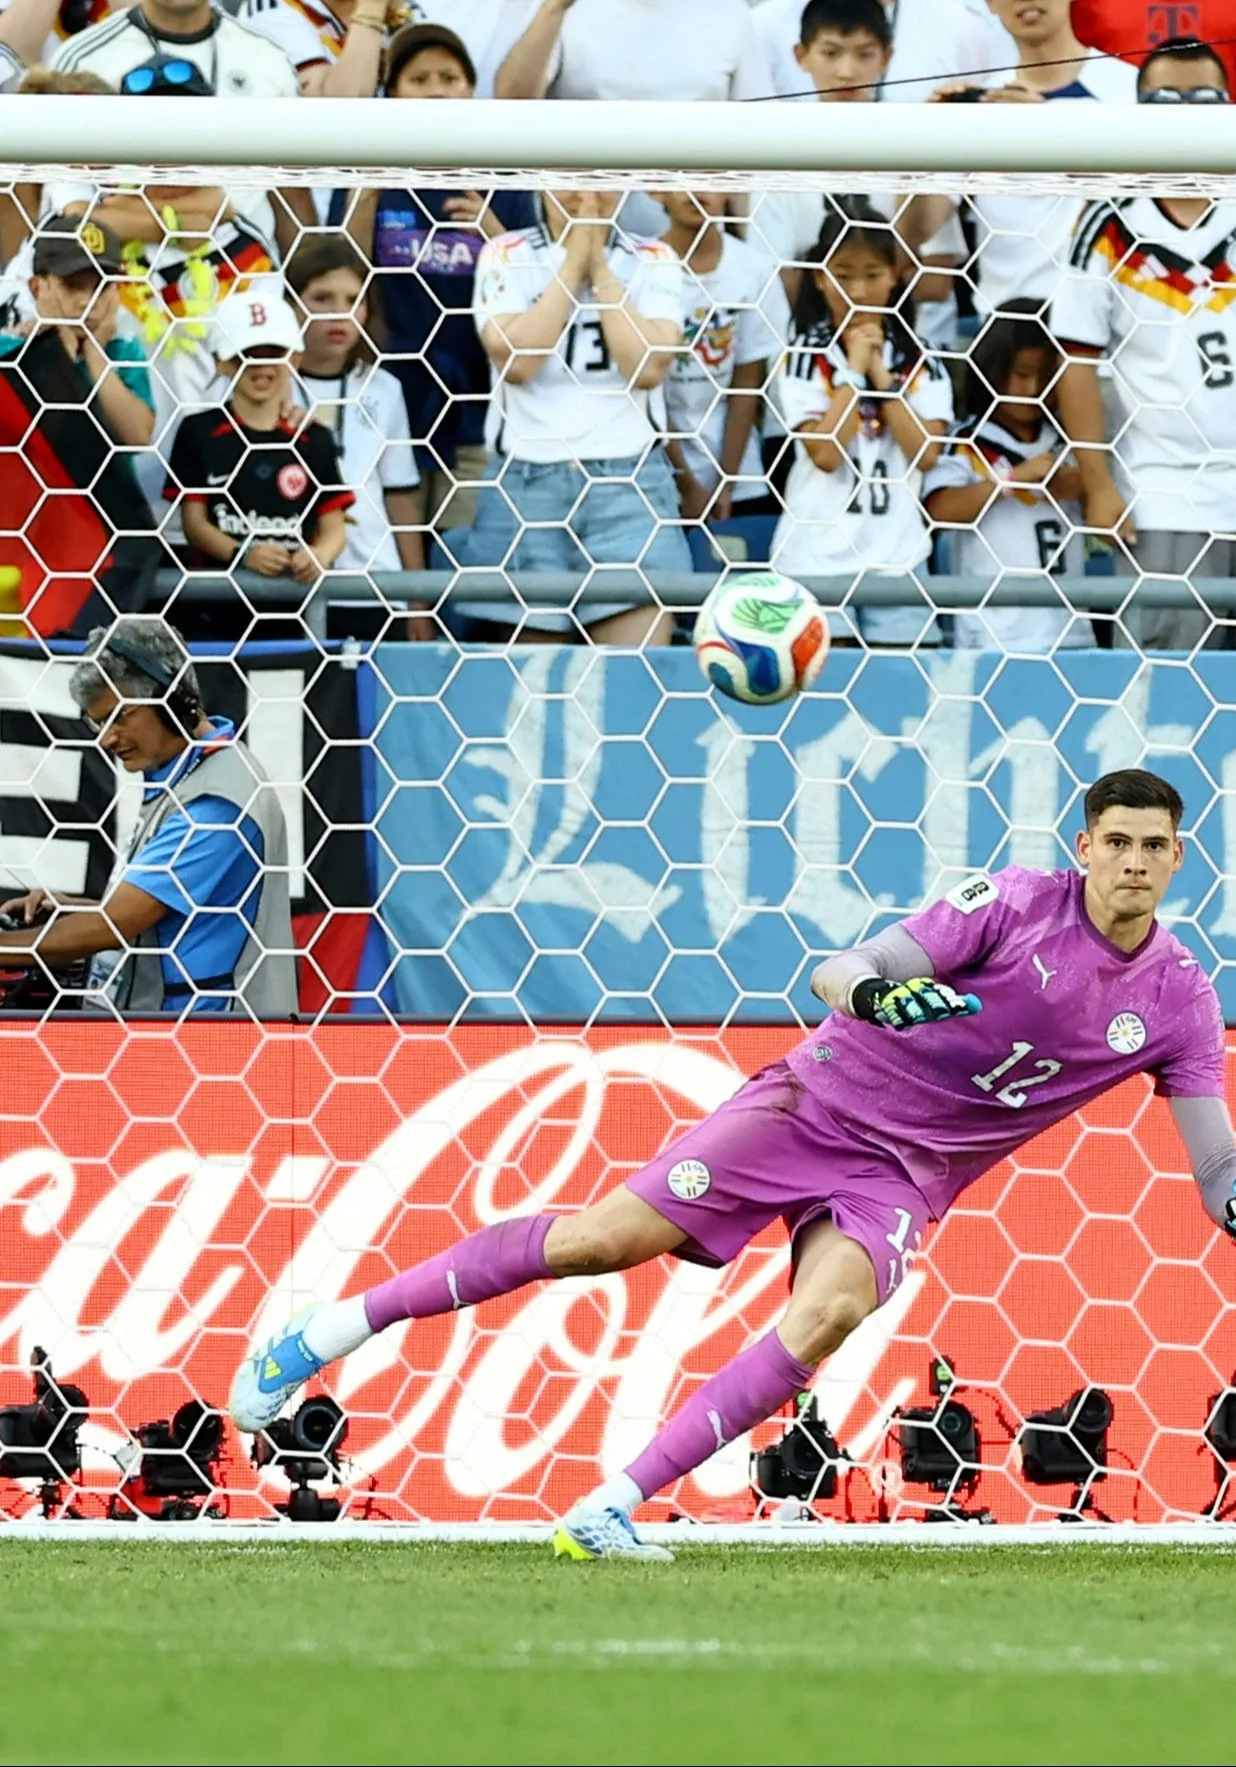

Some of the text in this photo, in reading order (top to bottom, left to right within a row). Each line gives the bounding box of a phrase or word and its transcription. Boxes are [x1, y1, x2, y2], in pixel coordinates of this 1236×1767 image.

[249, 303, 267, 326] B
[1196, 331, 1233, 389] 6
[1035, 519, 1067, 575] 6
[971, 1041, 1063, 1109] 12
